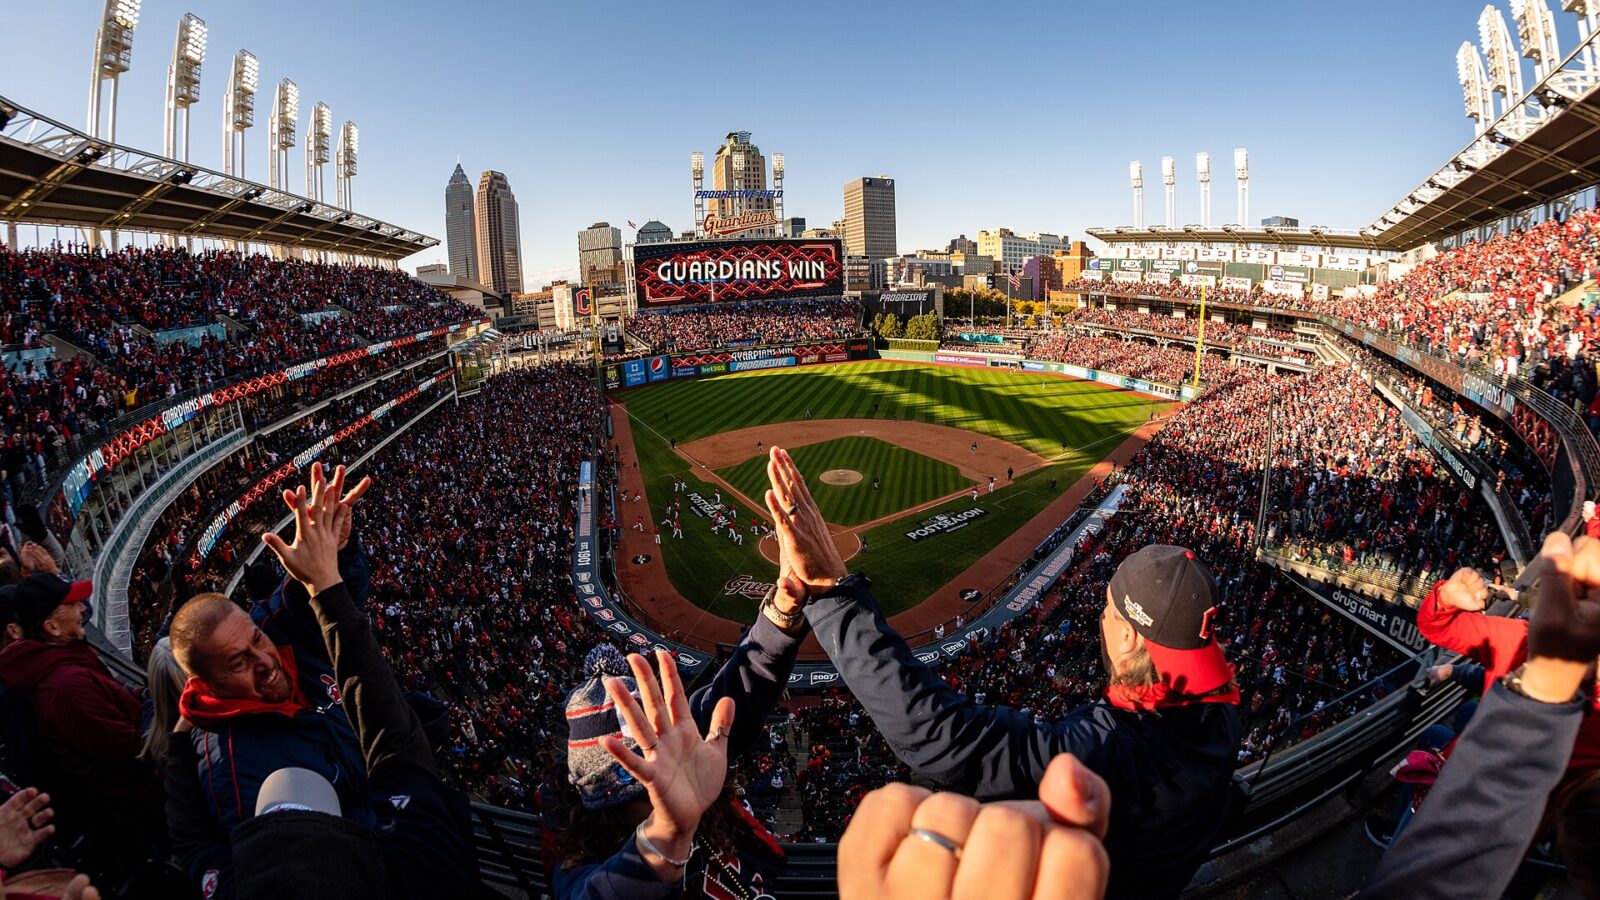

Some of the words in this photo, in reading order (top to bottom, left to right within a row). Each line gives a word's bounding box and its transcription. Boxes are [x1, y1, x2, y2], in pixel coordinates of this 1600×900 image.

[695, 190, 756, 199] PROGRESSIVE
[757, 190, 784, 199] FIELD
[703, 209, 778, 237] Guardians
[657, 260, 782, 282] GUARDIANS
[787, 260, 825, 280] WIN
[880, 292, 929, 302] PROGRESSIVE
[285, 360, 316, 378] GUARDIANS
[701, 365, 725, 373] bet365
[736, 357, 789, 370] PROGRESSIVE
[1462, 373, 1502, 405] GUARDIANS
[162, 399, 199, 425] GUARDIANS
[199, 392, 214, 409] WIN
[293, 441, 324, 467] GUARDIANS
[197, 511, 228, 555] GUARDIANS
[227, 500, 241, 519] WIN
[906, 507, 985, 540] POSTSEASON
[578, 550, 591, 566] 1901
[1332, 590, 1358, 614] drug
[1358, 605, 1388, 627] mart
[1389, 615, 1426, 651] CLUB
[946, 642, 964, 652] 2018
